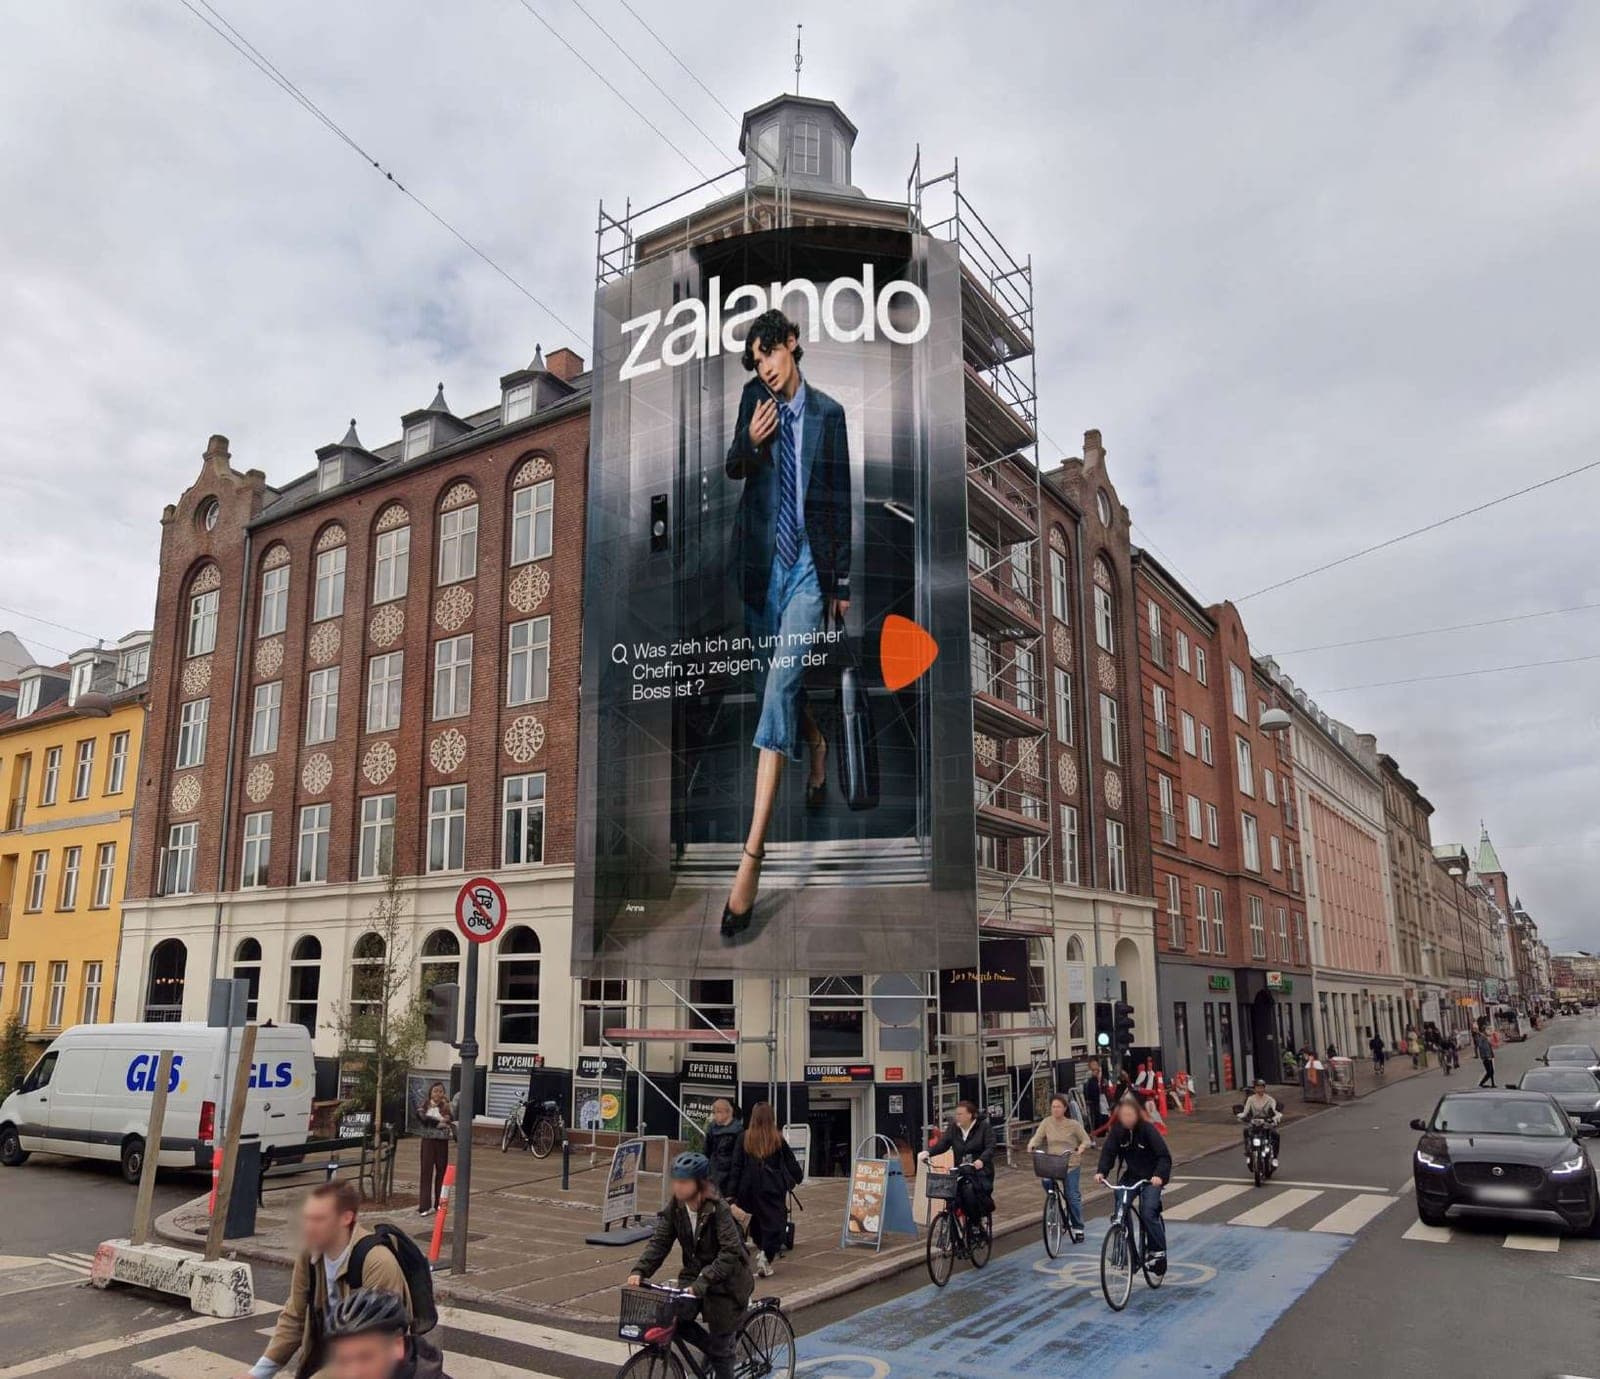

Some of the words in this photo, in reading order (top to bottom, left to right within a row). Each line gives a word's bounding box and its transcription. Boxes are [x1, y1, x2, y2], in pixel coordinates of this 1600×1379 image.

[619, 263, 931, 381] zalando
[633, 643, 667, 659] Was
[671, 638, 701, 656] zieh
[705, 636, 728, 653] ich
[732, 636, 755, 652] an,
[759, 634, 783, 649] um
[788, 628, 843, 647] meiner
[632, 661, 683, 681] Chefin
[687, 664, 705, 676] zu
[709, 657, 764, 676] zeigen,
[769, 654, 797, 669] wer
[801, 651, 828, 667] der
[632, 682, 671, 700] Boss
